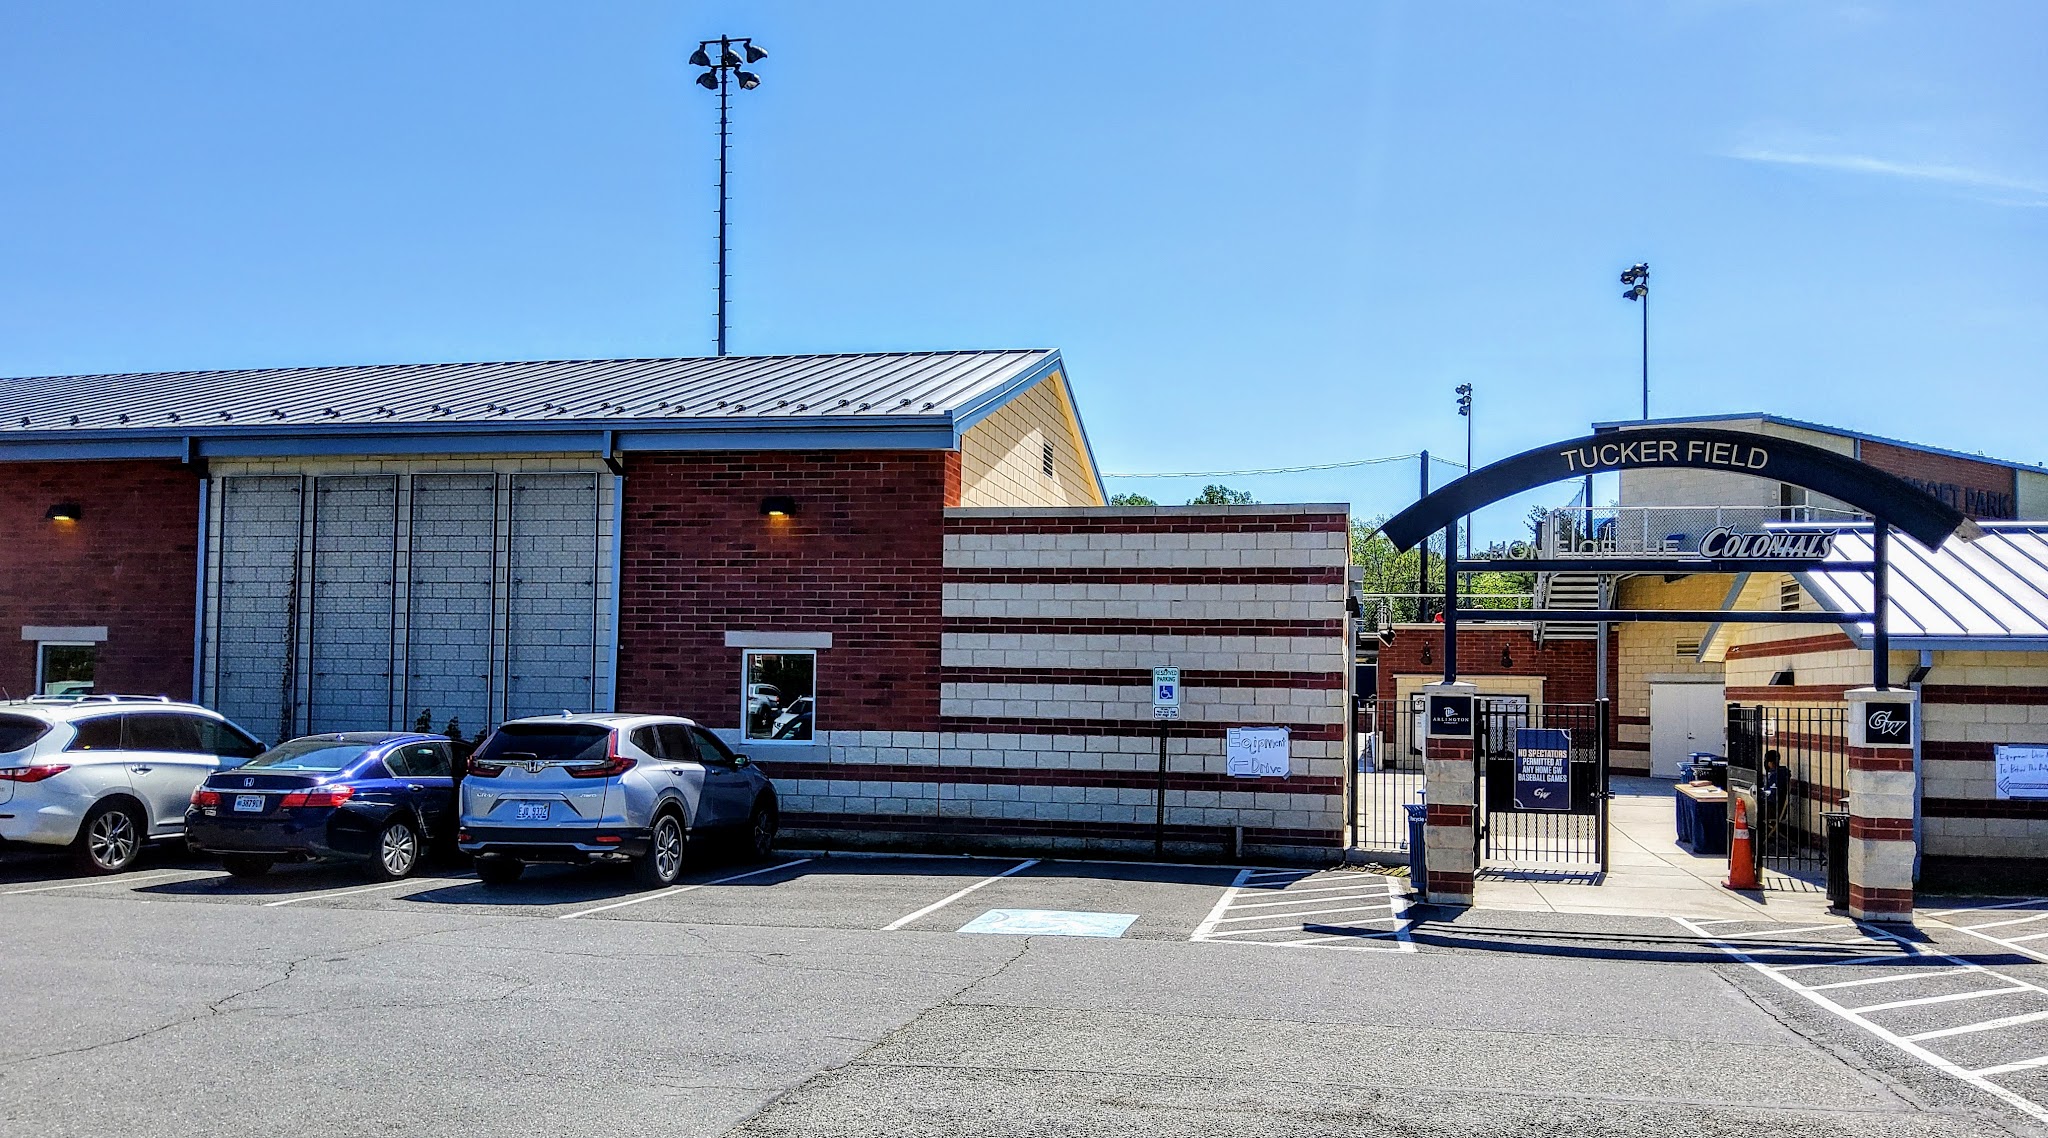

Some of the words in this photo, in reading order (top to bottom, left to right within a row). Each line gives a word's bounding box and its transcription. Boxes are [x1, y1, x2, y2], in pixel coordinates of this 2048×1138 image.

[1561, 441, 1679, 471] TUCKER
[1687, 441, 1768, 469] FIELD
[1965, 487, 2011, 518] PARK
[1489, 540, 1569, 560] HOME
[1579, 540, 1616, 560] OF
[1625, 540, 1680, 560] THE
[1699, 523, 1840, 559] COLONIALS
[1868, 710, 1908, 736] GW
[1518, 749, 1527, 757] NO
[1528, 749, 1568, 758] SPECTATORS
[1251, 758, 1282, 774] Drive
[1522, 758, 1554, 766] PERMITTED
[1555, 758, 1563, 766] AT
[1522, 765, 1534, 773] ANY
[1535, 766, 1552, 774] HOME
[1518, 773, 1546, 782] BASEBALL
[1547, 774, 1568, 782] GAMES
[1533, 787, 1551, 799] GW
